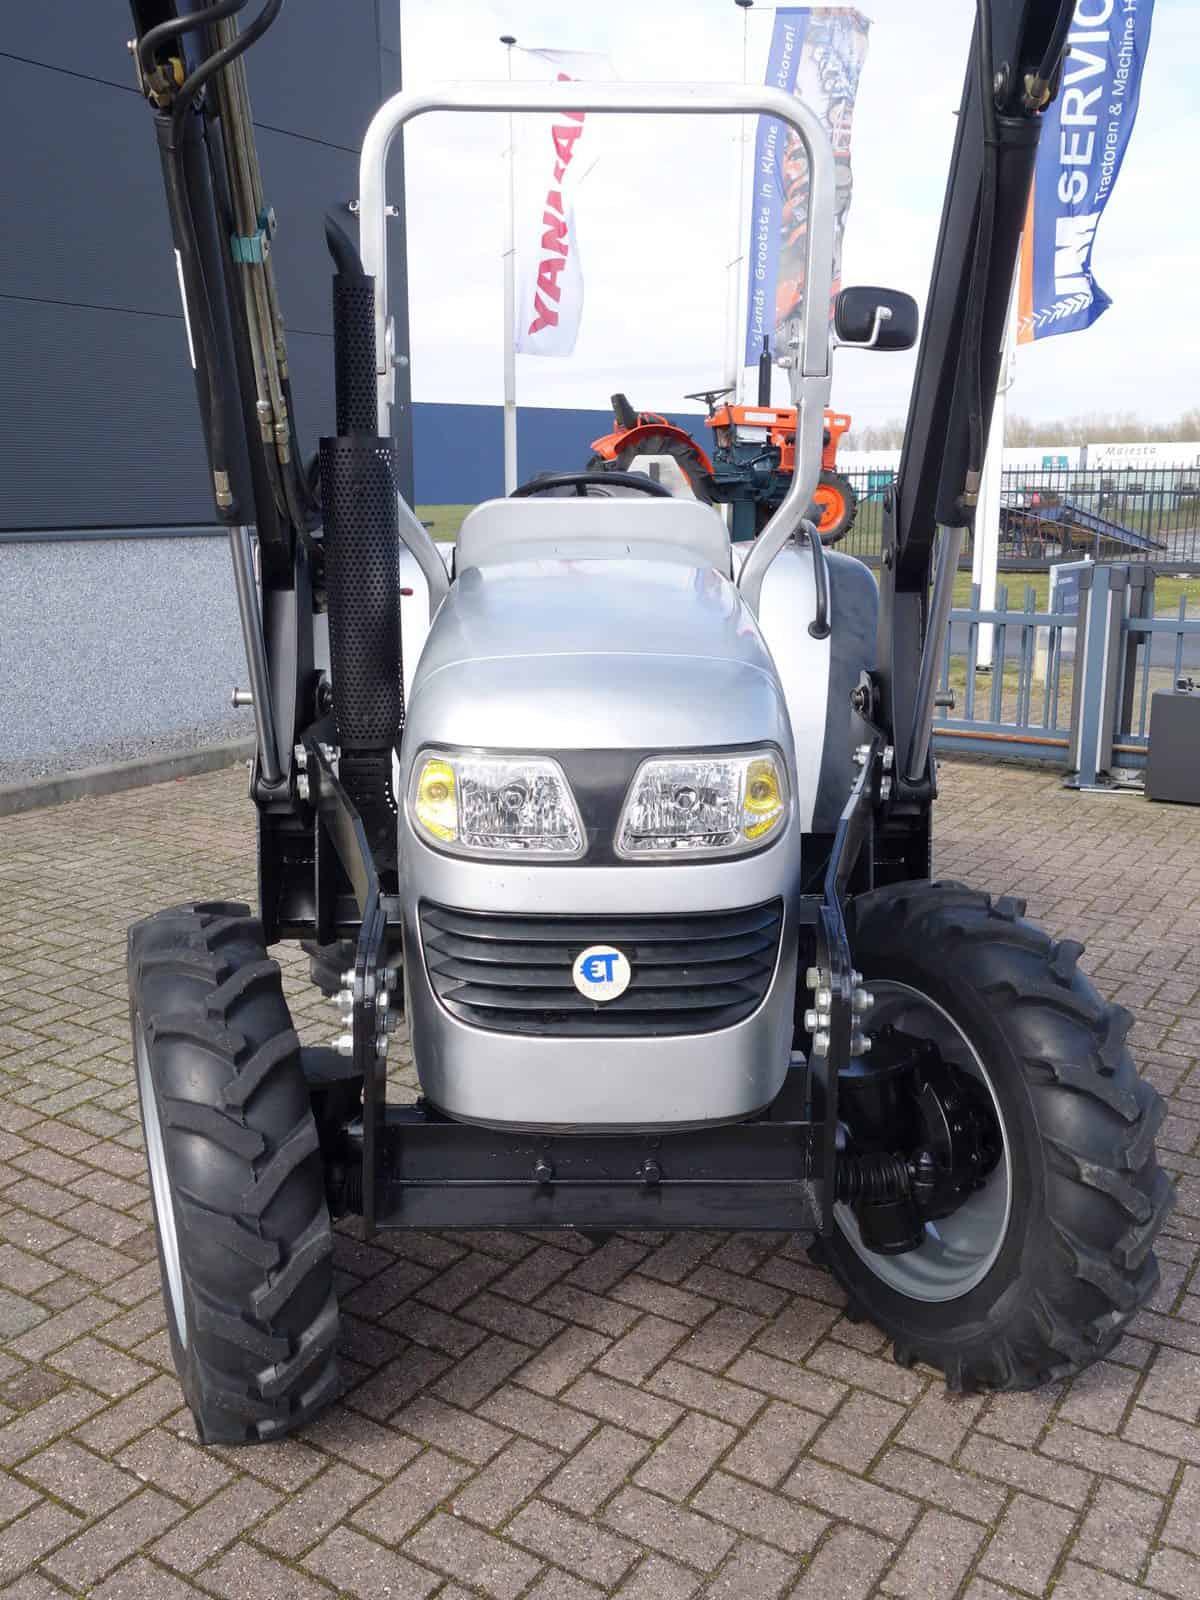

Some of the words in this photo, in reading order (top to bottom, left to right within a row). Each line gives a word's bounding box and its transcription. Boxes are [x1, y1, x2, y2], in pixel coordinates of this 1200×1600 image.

[777, 23, 797, 88] ctoren!
[1111, 17, 1136, 96] Machine
[1108, 103, 1123, 116] &
[761, 125, 779, 176] Kleine
[1094, 121, 1120, 204] Tractoren
[754, 207, 771, 281] Grootste
